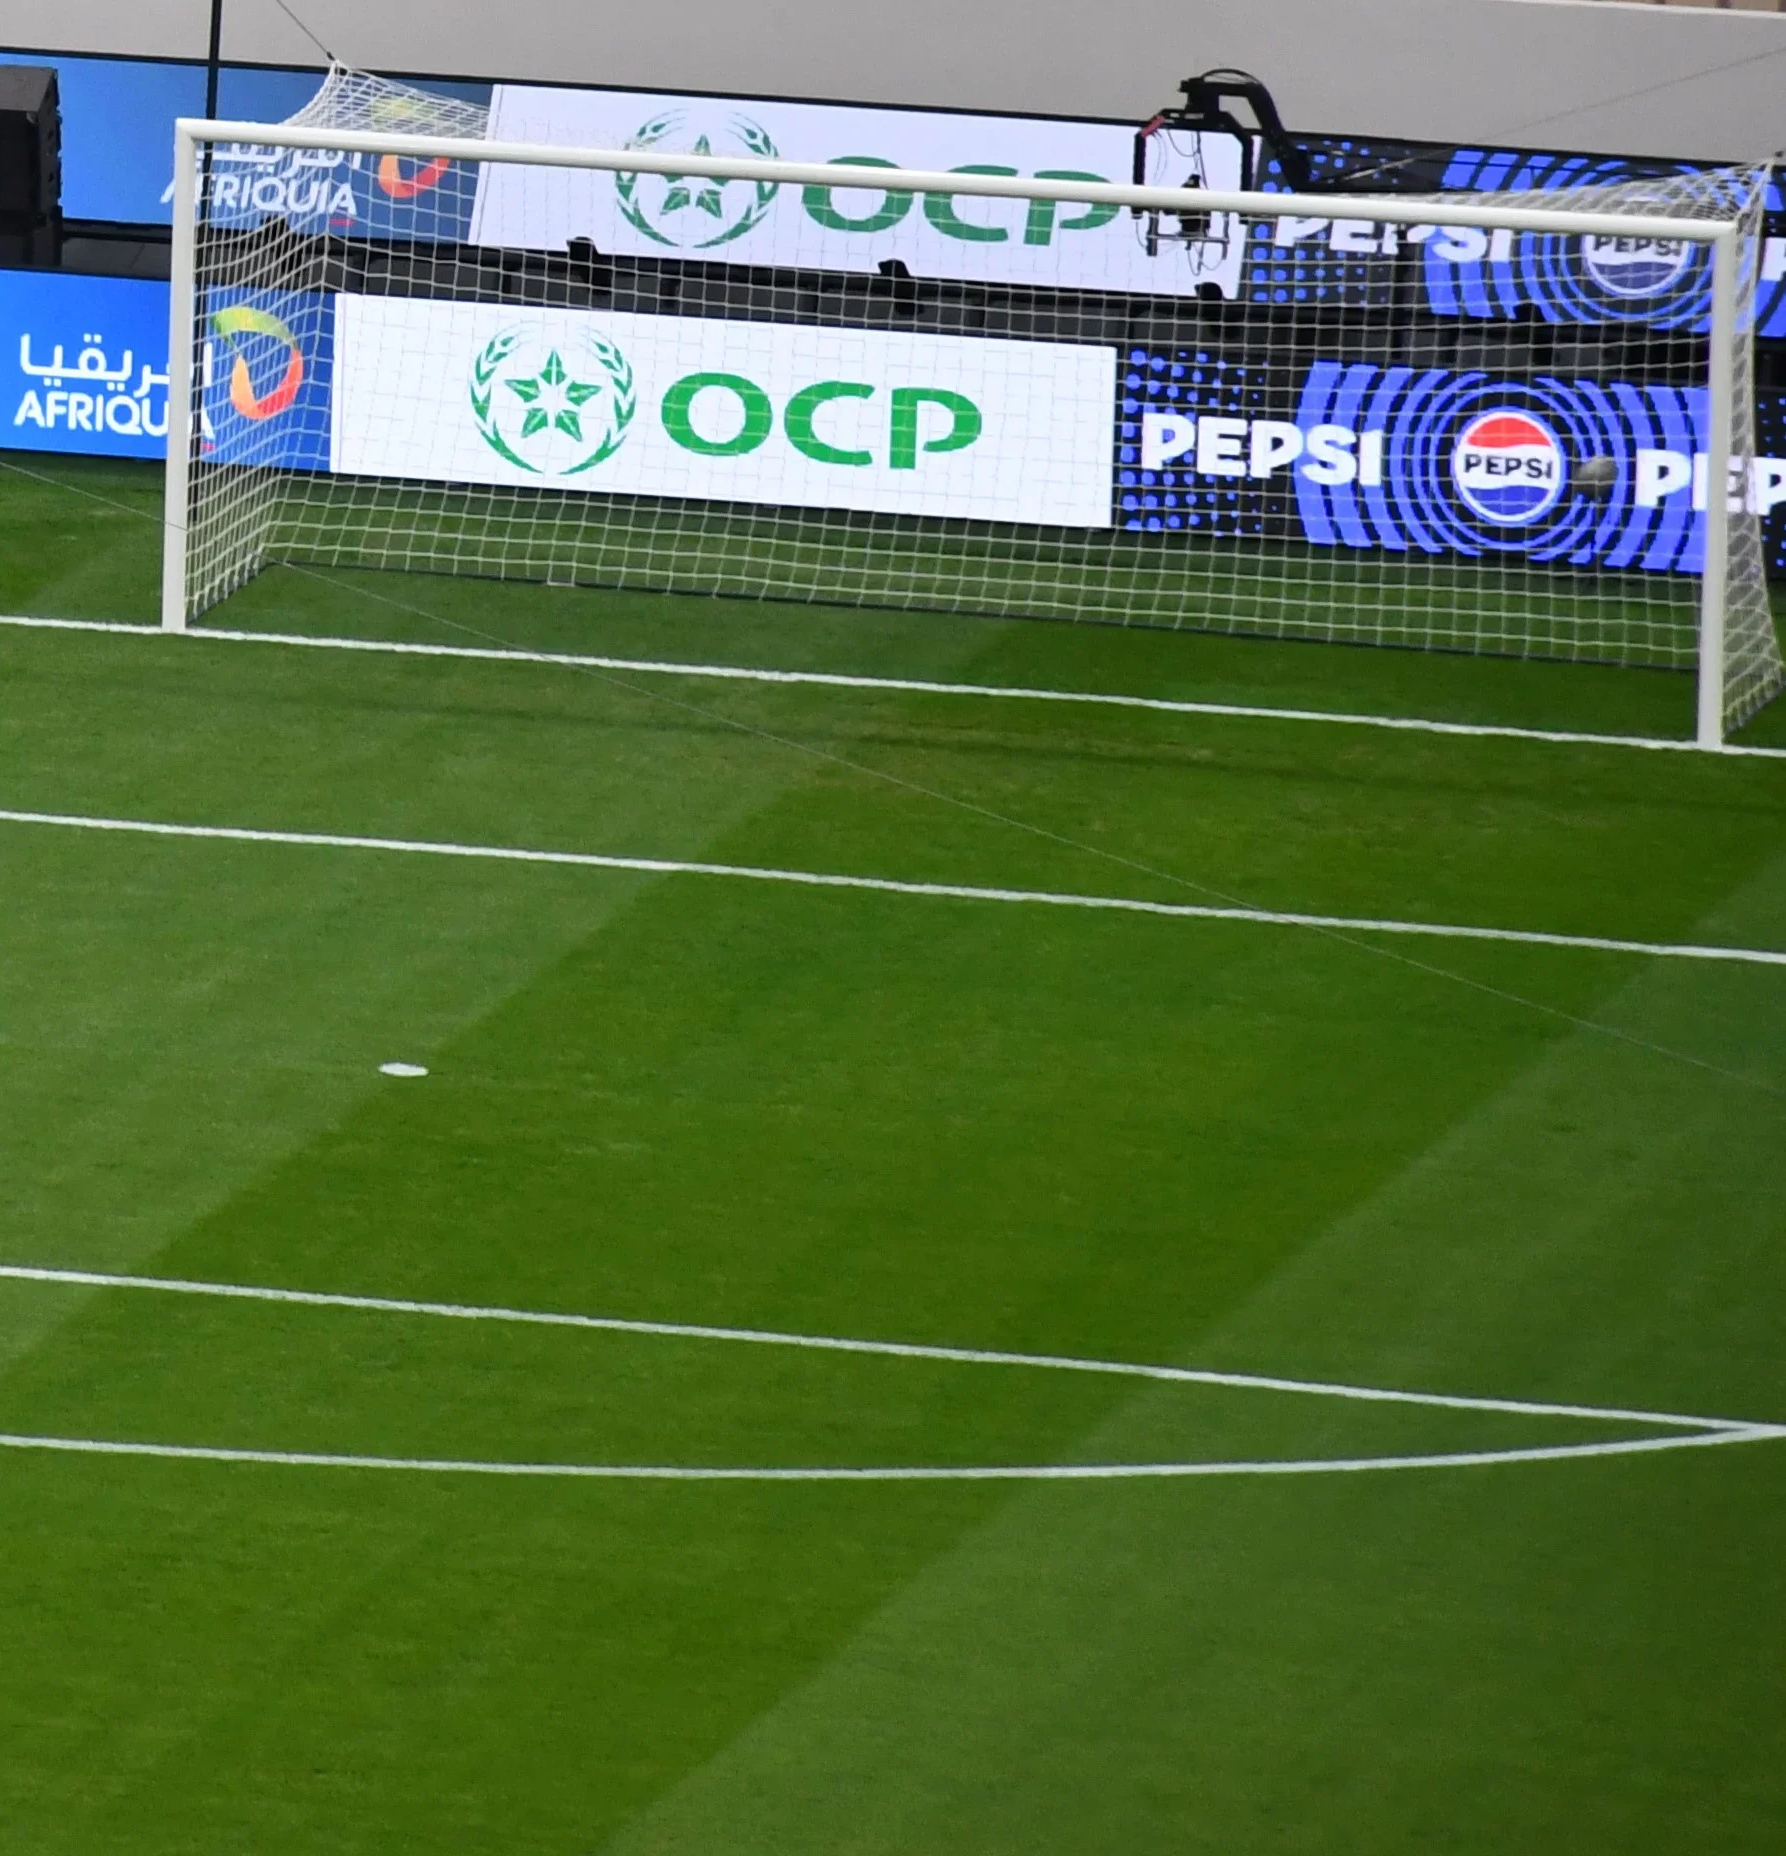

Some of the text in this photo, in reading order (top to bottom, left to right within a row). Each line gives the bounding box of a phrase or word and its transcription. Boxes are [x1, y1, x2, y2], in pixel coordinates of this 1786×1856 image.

[160, 173, 357, 217] RIQUIA
[802, 155, 1122, 246] OCP
[660, 372, 982, 470] OCP
[1141, 413, 1382, 486] PEPSI
[1464, 453, 1553, 479] PEPSI
